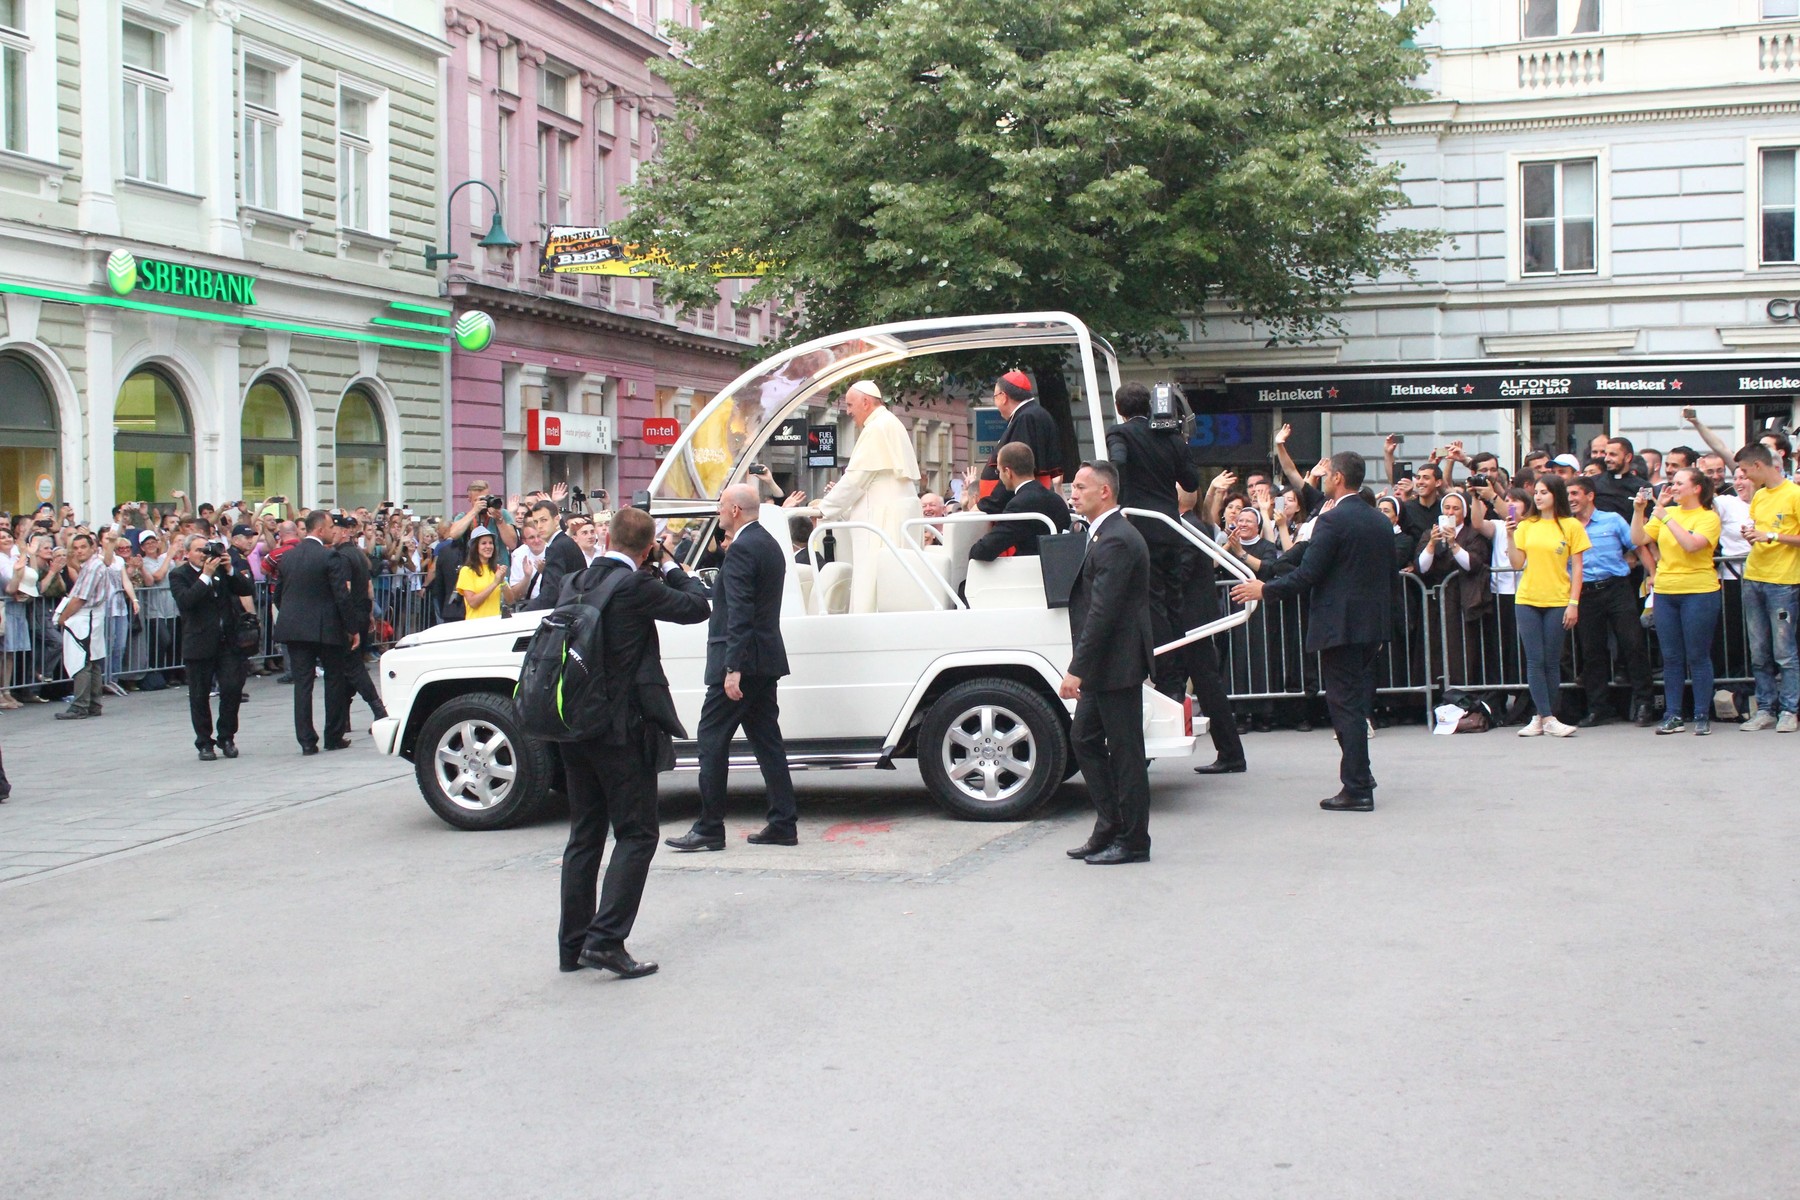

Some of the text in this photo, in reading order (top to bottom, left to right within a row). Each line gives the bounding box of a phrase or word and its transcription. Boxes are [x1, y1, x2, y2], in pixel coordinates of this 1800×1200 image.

[566, 239, 611, 252] SARAJEVO
[558, 248, 612, 265] BEER
[564, 264, 608, 273] FESTIVAL
[141, 259, 257, 305] SBERBANK
[1499, 378, 1571, 389] ALFONSO
[1596, 379, 1665, 390] Heineken
[1739, 377, 1800, 390] Heineke
[1258, 388, 1323, 401] Heineken
[1391, 384, 1457, 396] Heineken
[1500, 386, 1569, 396] COFFEE BAR
[546, 426, 560, 437] m:tel
[646, 425, 674, 436] m:tel
